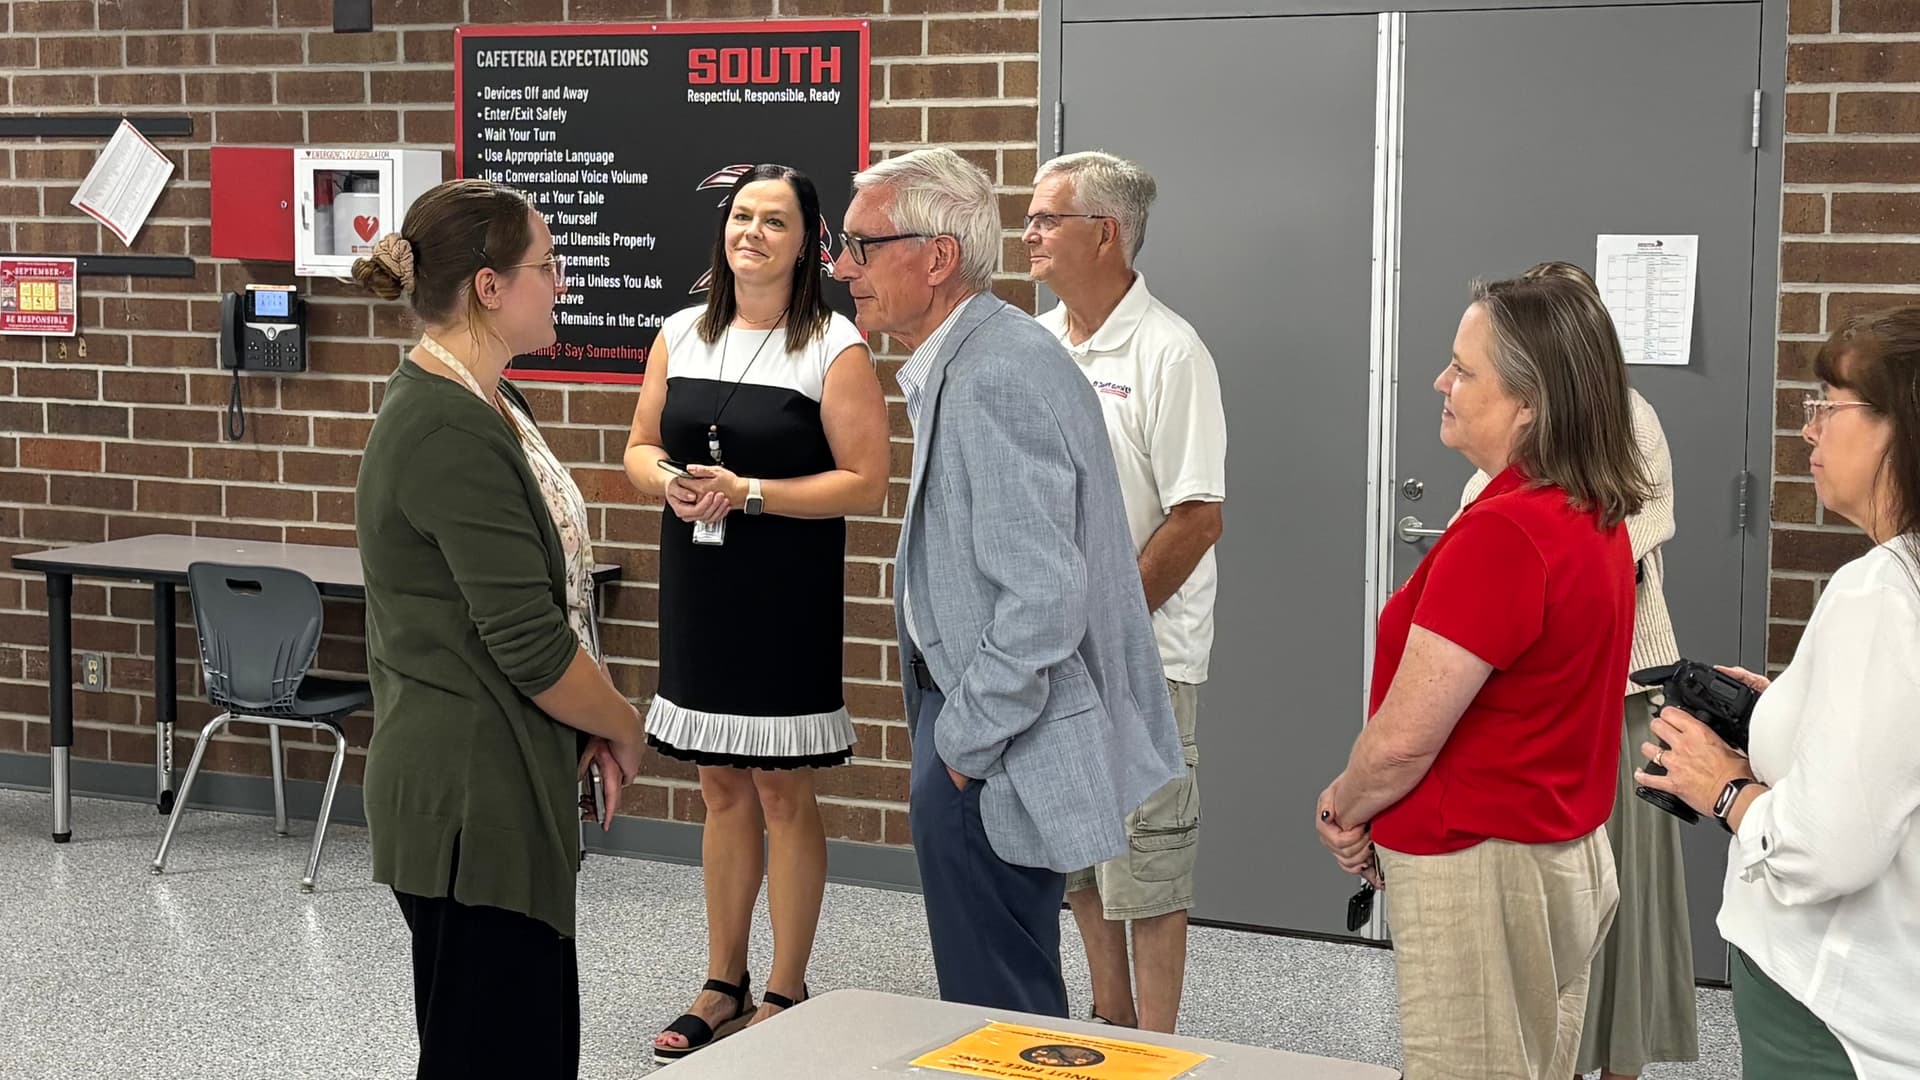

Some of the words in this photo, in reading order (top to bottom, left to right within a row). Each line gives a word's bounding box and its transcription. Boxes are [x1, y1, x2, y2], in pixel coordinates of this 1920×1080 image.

[476, 50, 548, 68] CAFETERIA
[550, 48, 649, 67] EXPECTATIONS
[688, 46, 841, 84] SOUTH
[484, 86, 522, 100] Devices
[524, 86, 540, 100] Off
[542, 86, 561, 100] and
[562, 86, 589, 103] Away
[687, 88, 742, 105] Respectful,
[744, 88, 807, 105] Responsible,
[809, 88, 841, 105] Ready
[484, 106, 534, 121] Enter/Exit
[536, 106, 568, 124] Safely
[484, 128, 507, 142] Wait
[508, 128, 531, 142] Your
[533, 128, 557, 142] Turn
[484, 148, 503, 162] Use
[505, 148, 564, 166] Appropriate
[565, 149, 615, 166] Language
[484, 169, 503, 182] Use
[505, 169, 579, 184] Conversational
[580, 170, 609, 184] Voice
[611, 170, 649, 185] Volume
[540, 191, 550, 204] at
[552, 190, 575, 204] Your
[577, 190, 605, 205] Table
[557, 211, 598, 226] Yourself
[570, 232, 611, 247] Utensils
[613, 233, 656, 251] Properly
[587, 274, 621, 289] Unless
[623, 275, 642, 289] You
[643, 275, 663, 289] Ask
[561, 311, 605, 326] Remains
[606, 313, 616, 327] in
[618, 313, 636, 327] the
[637, 314, 666, 328] Cafet
[564, 343, 585, 361] Say
[586, 344, 648, 363] Something!
